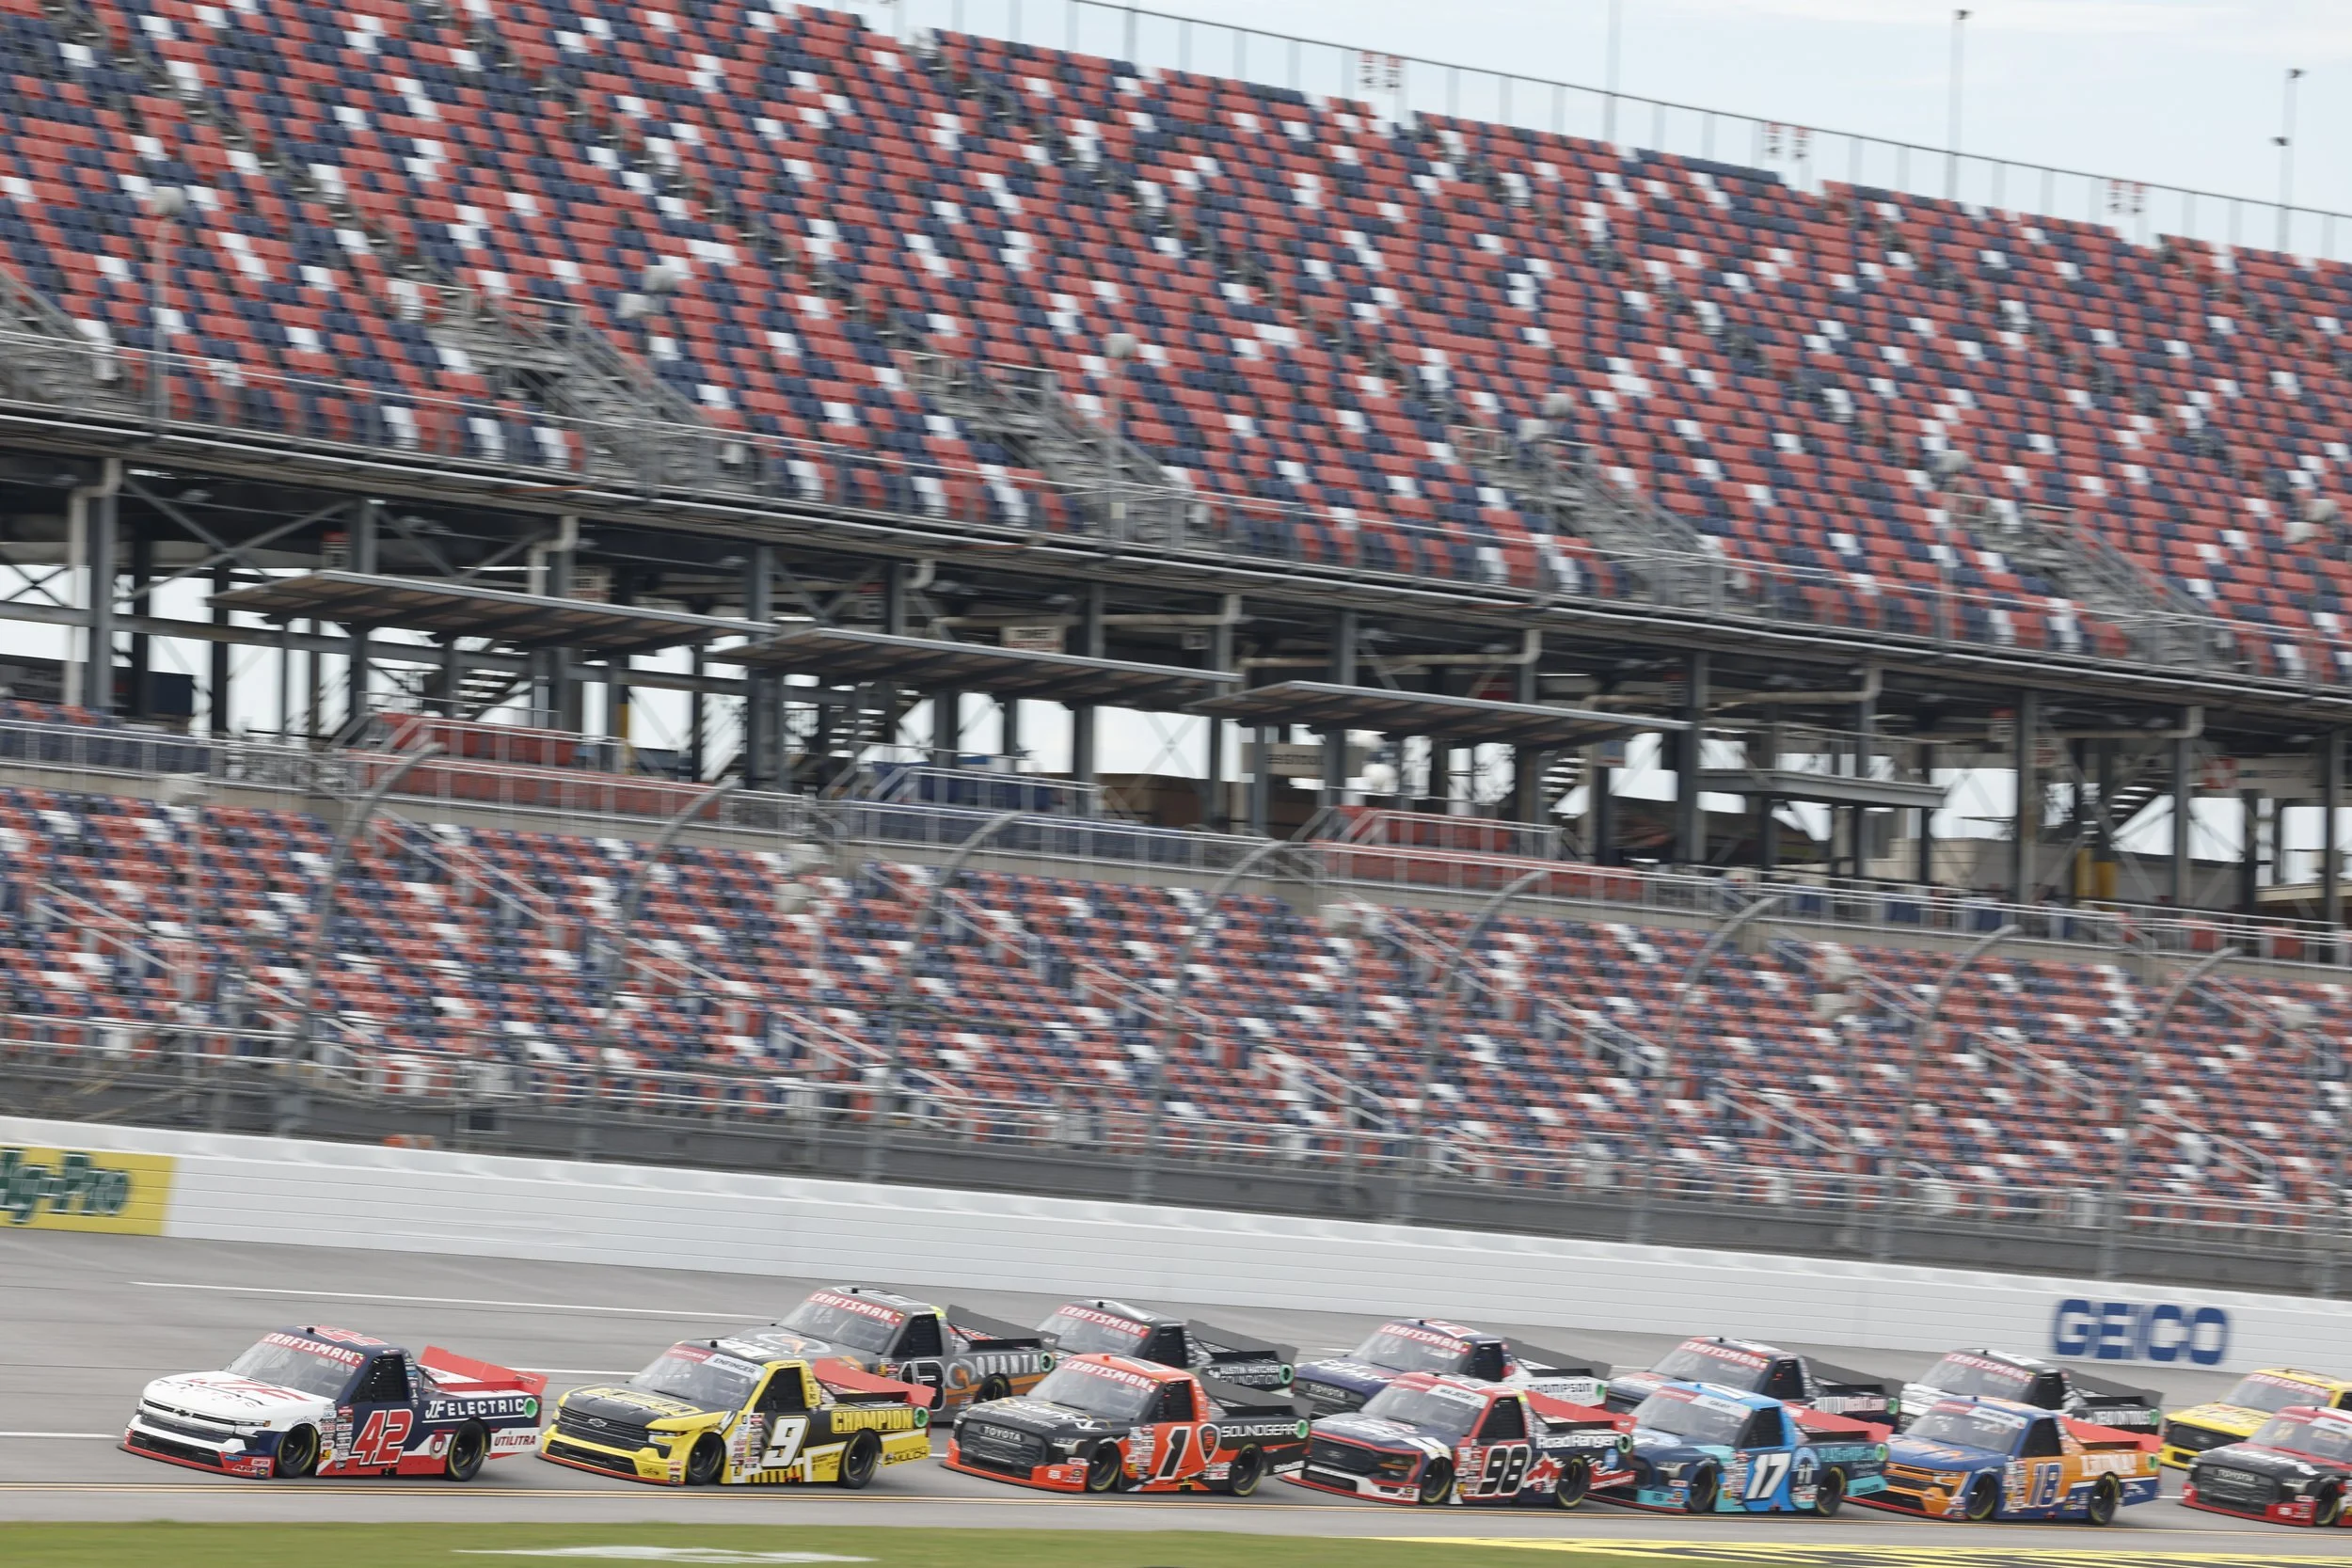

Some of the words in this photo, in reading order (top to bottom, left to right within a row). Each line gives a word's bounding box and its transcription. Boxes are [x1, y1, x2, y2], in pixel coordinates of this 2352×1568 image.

[810, 1292, 894, 1321] CRAFTSMAN
[1058, 1306, 1142, 1336] CRAFTSMAN
[1380, 1324, 1464, 1351] CRAFTSMAN
[2053, 1298, 2230, 1365] GEICO
[262, 1331, 356, 1363] CRAFTSMAN
[1681, 1340, 1759, 1368] CRAFTSMAN
[976, 1354, 1041, 1378] QUANTA
[1064, 1360, 1151, 1390] CRAFTSMAN
[1528, 1383, 1592, 1394] THOMPSON
[447, 1398, 524, 1417] ELECTRIC
[833, 1409, 913, 1433] CHAMPION
[350, 1409, 414, 1465] 42
[494, 1435, 536, 1447] UTILITRA
[761, 1415, 811, 1470] 9
[983, 1426, 1022, 1442] TOYOTA
[1220, 1423, 1297, 1437] SOUNDGEAR
[1155, 1425, 1192, 1481] 1
[1478, 1444, 1533, 1497] 98
[1745, 1452, 1792, 1500] 17
[2027, 1462, 2064, 1507] 18
